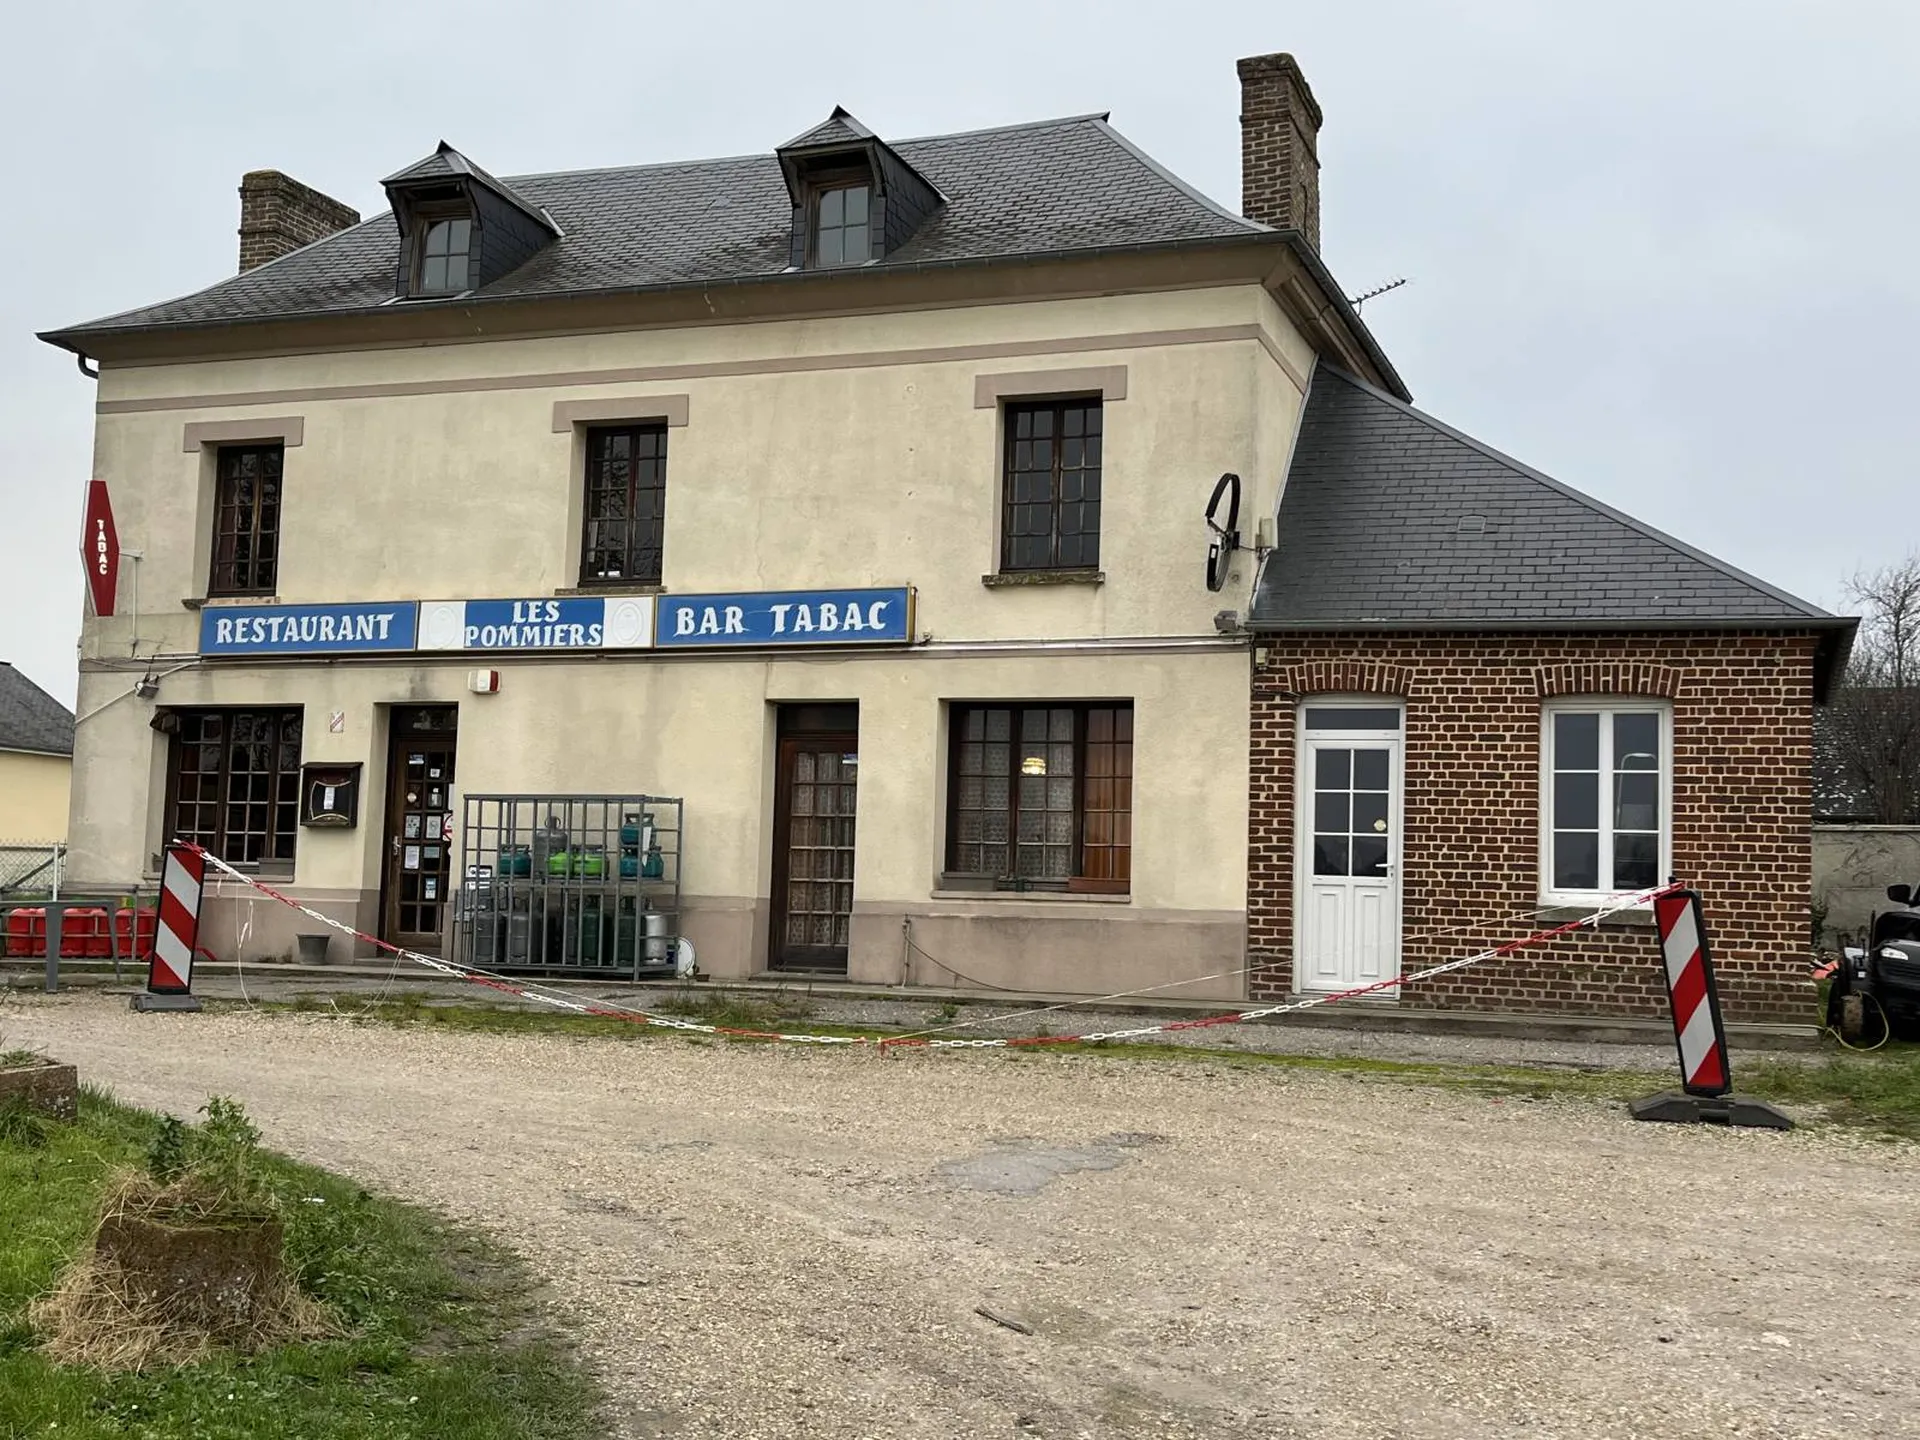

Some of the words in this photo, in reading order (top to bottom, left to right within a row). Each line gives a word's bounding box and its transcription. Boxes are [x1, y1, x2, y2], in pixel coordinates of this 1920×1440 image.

[97, 519, 108, 576] TABAC
[511, 600, 560, 624] LES
[675, 606, 747, 637] BAR
[770, 601, 892, 633] TABAC
[215, 614, 394, 644] RESTAURANT
[465, 623, 602, 648] POMMIERS
